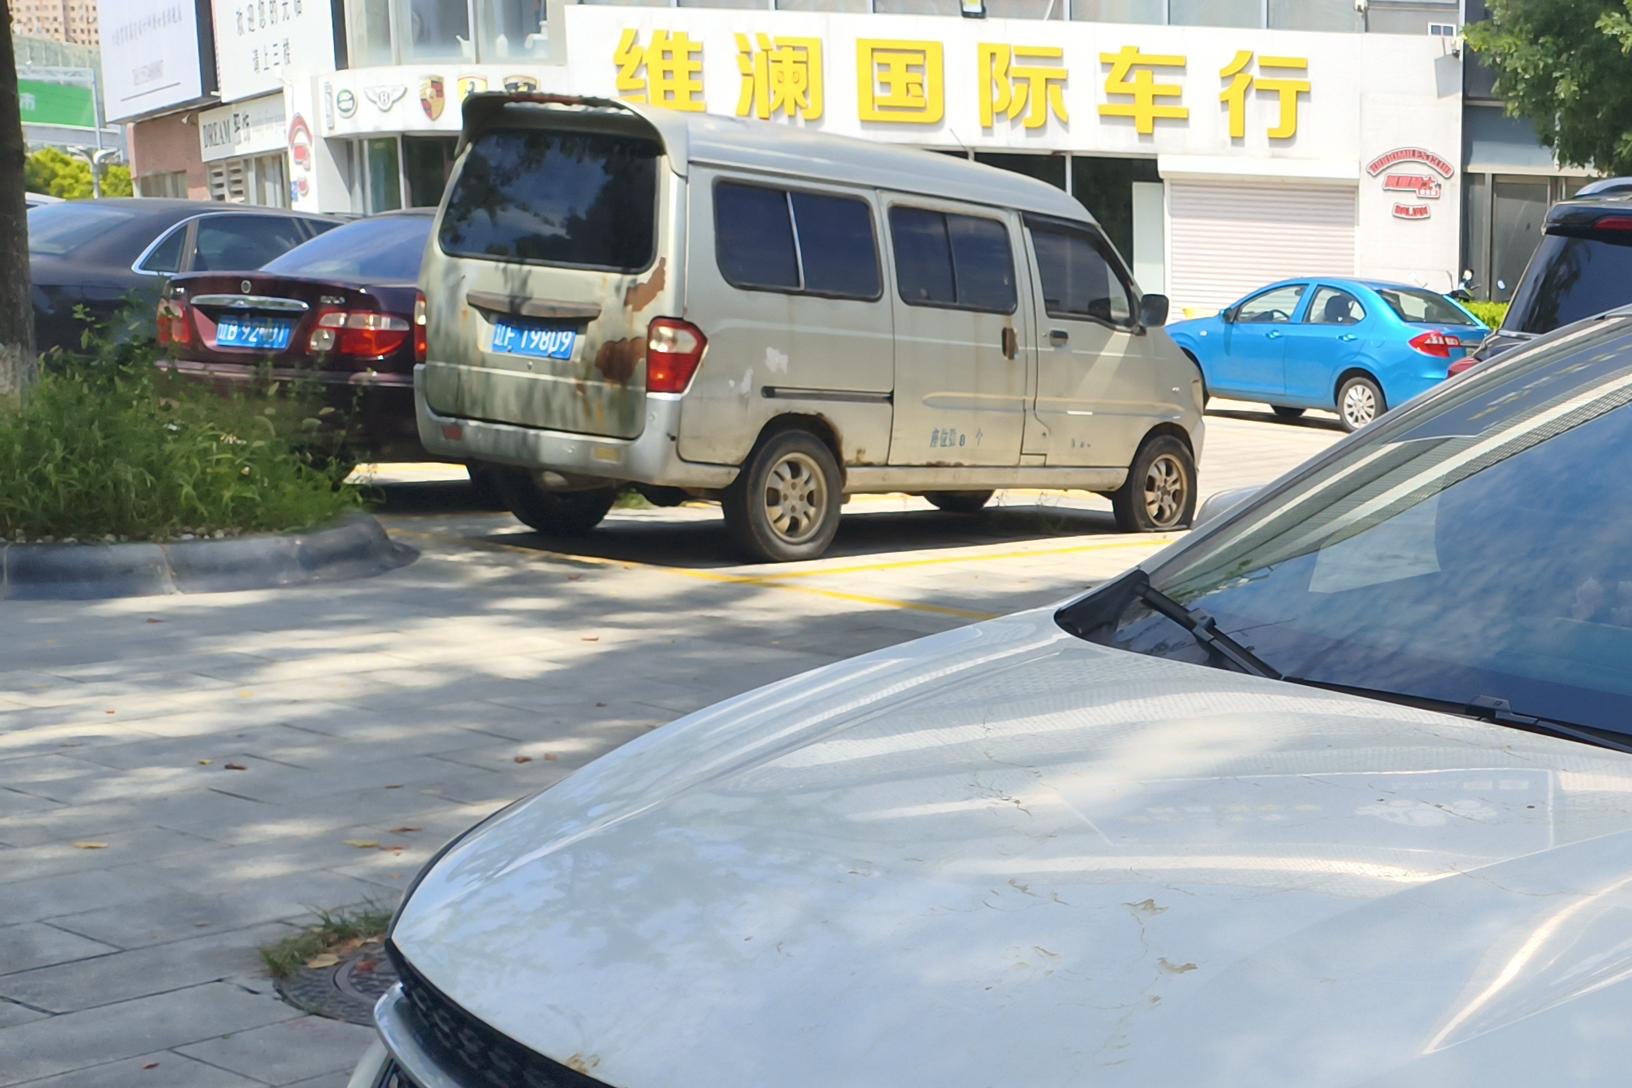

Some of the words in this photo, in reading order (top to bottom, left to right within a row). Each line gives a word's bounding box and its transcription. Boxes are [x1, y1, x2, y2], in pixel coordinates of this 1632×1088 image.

[613, 27, 1312, 140] 维澜国际车行
